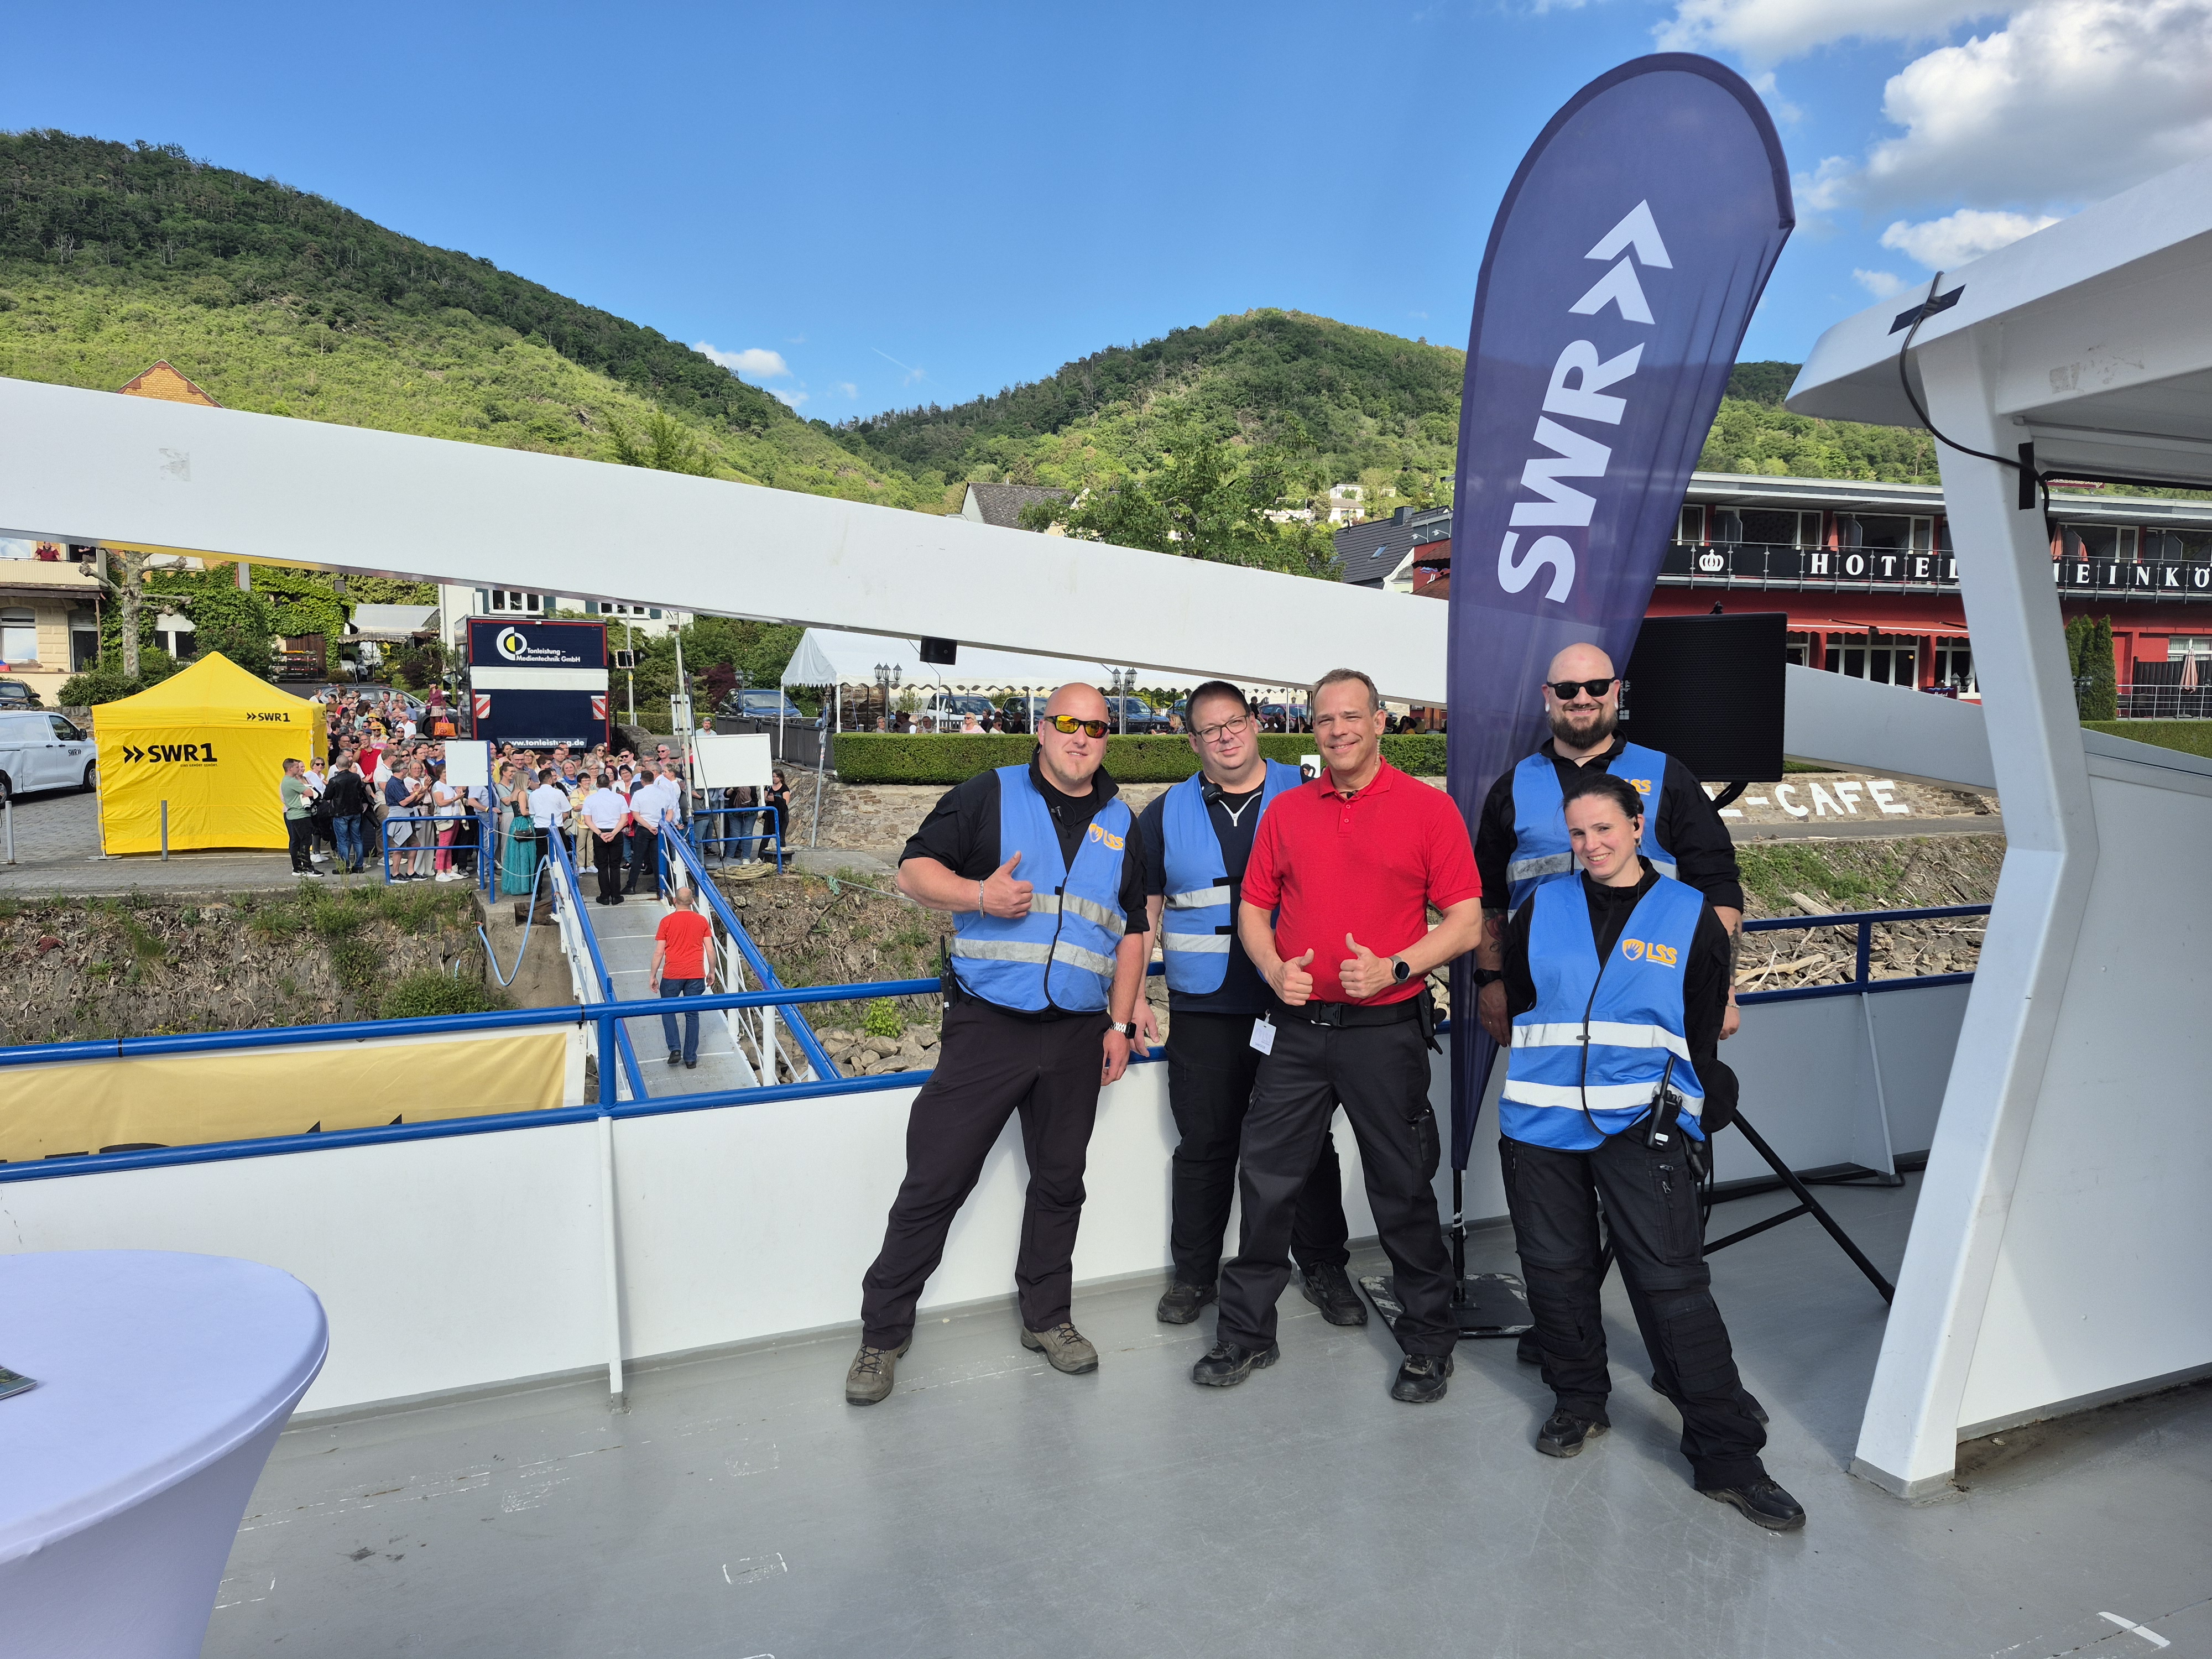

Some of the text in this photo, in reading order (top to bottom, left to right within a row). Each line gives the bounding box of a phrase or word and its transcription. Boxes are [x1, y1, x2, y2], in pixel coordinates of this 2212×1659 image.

[1498, 339, 1645, 603] SWR
[1809, 553, 1959, 579] HOTEL
[527, 648, 560, 656] Tonleistung
[258, 712, 291, 722] SWR1
[502, 738, 585, 747] ww.tonleistug.de
[68, 749, 77, 757] SWR
[148, 743, 218, 763] SWR1
[1624, 779, 1652, 793] SS
[1103, 830, 1124, 849] LSS
[1646, 942, 1678, 964] LSS
